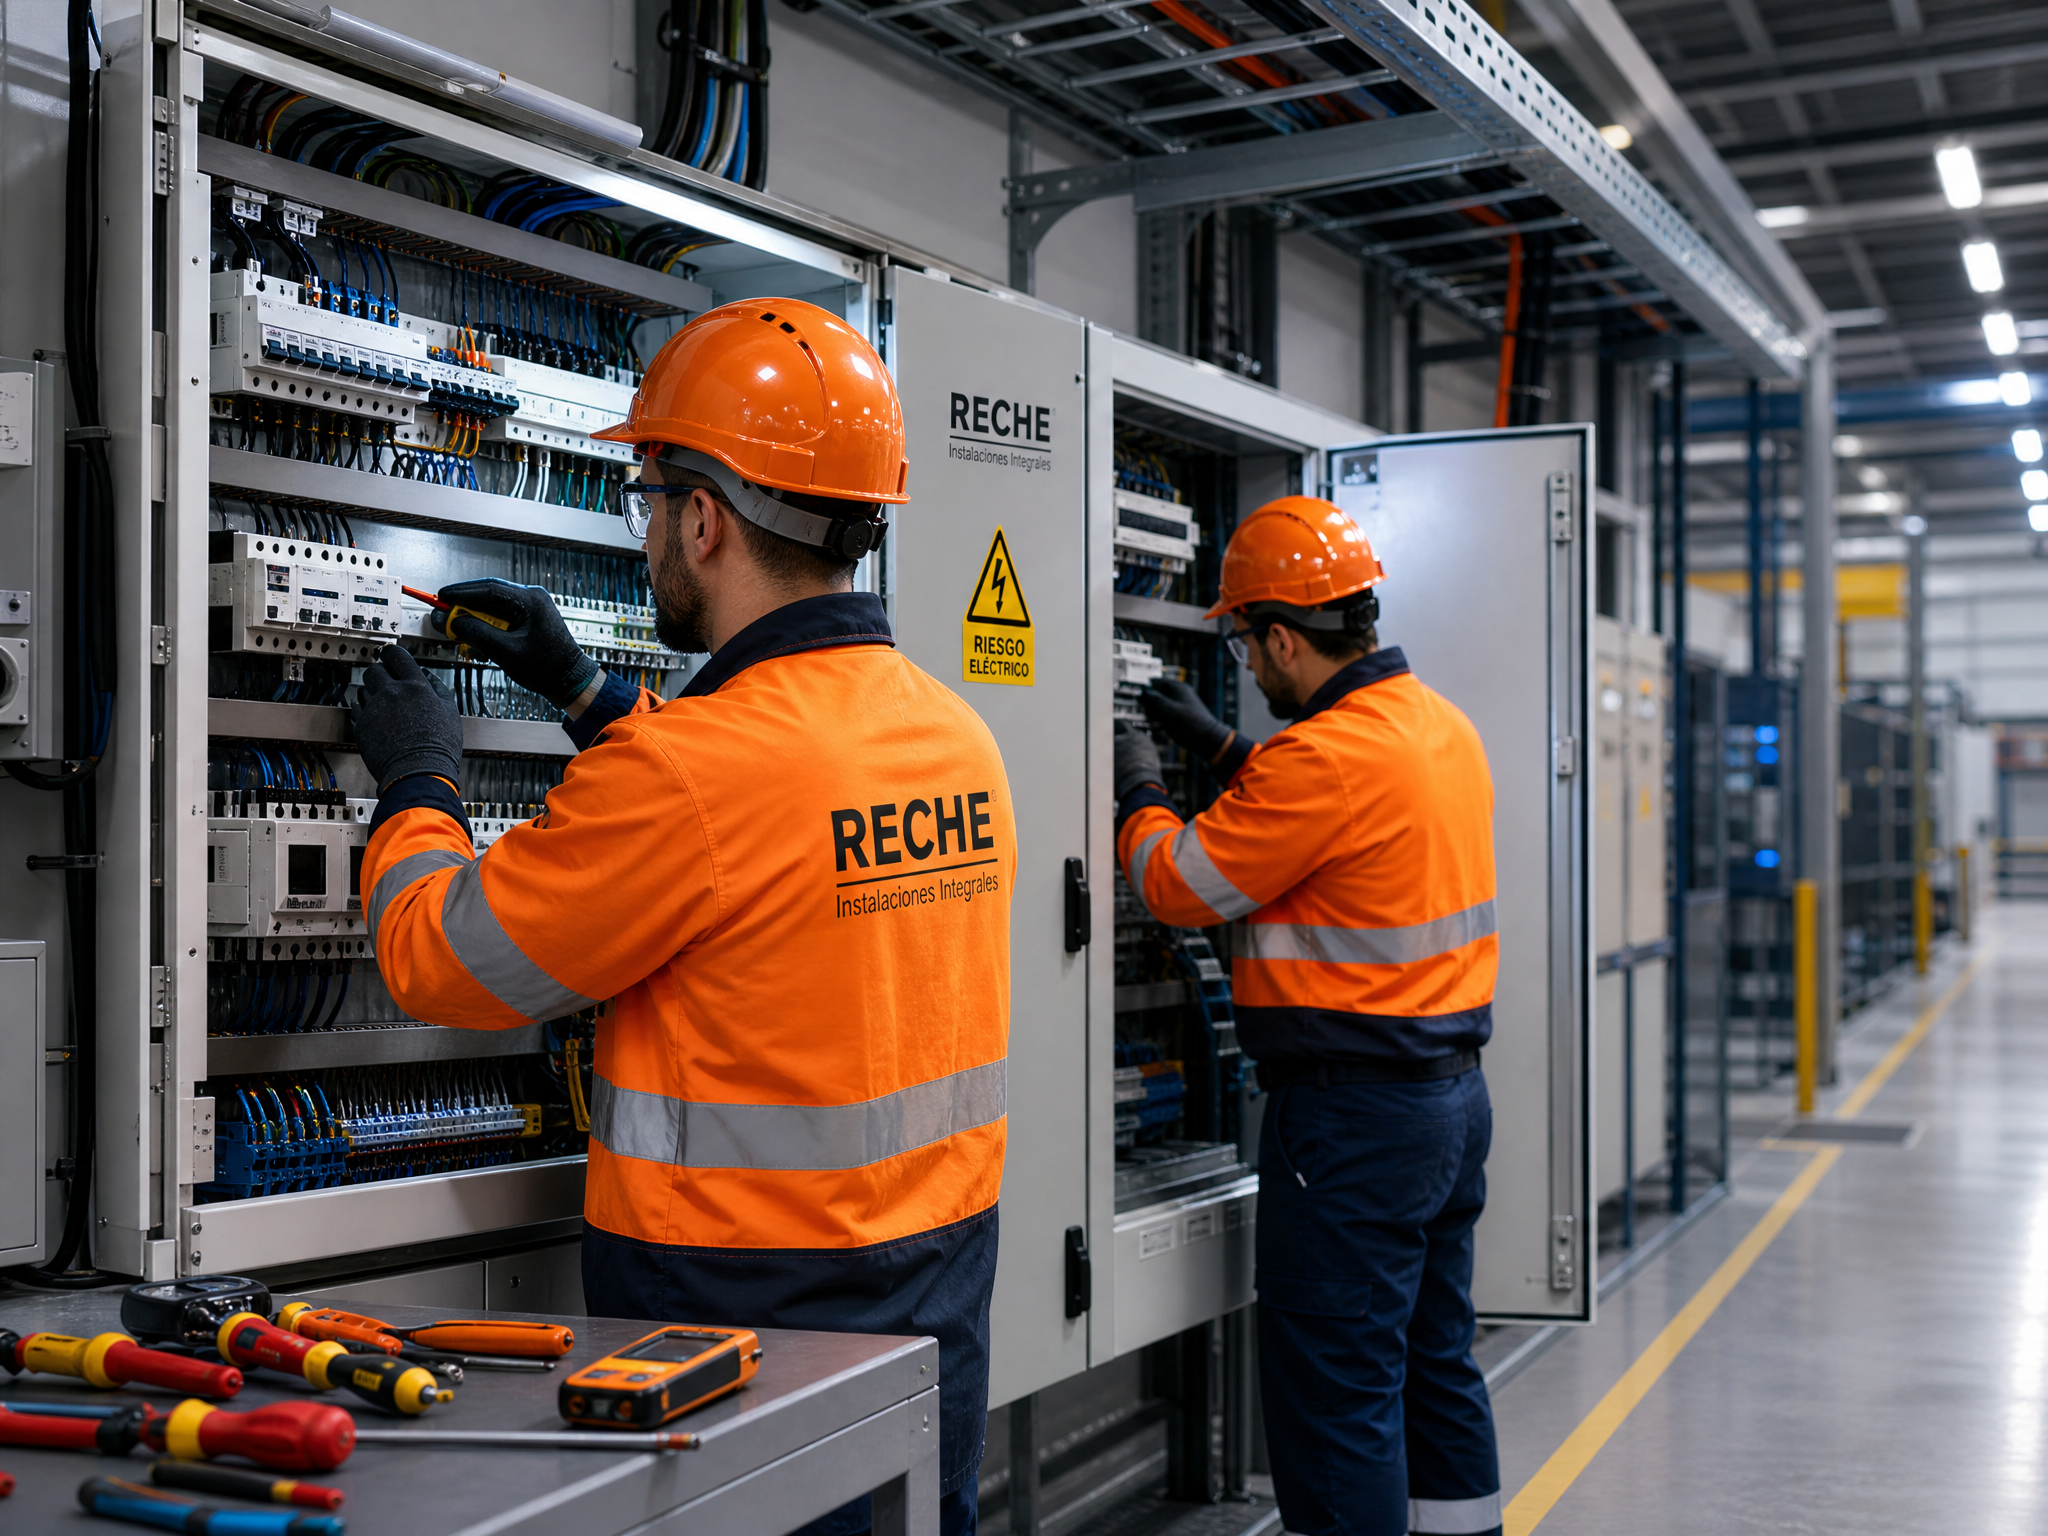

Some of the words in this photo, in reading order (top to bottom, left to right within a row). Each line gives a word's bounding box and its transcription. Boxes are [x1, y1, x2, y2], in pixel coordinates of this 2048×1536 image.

[950, 392, 1051, 443] RECHE
[949, 443, 1008, 466] Instalaciones
[1010, 452, 1051, 473] Integrales
[974, 635, 1025, 657] RIESGO
[969, 657, 1029, 678] ELÉCTRICO
[831, 791, 994, 873] RECHE
[836, 885, 936, 919] Instalaciones
[939, 871, 999, 903] Integrales
